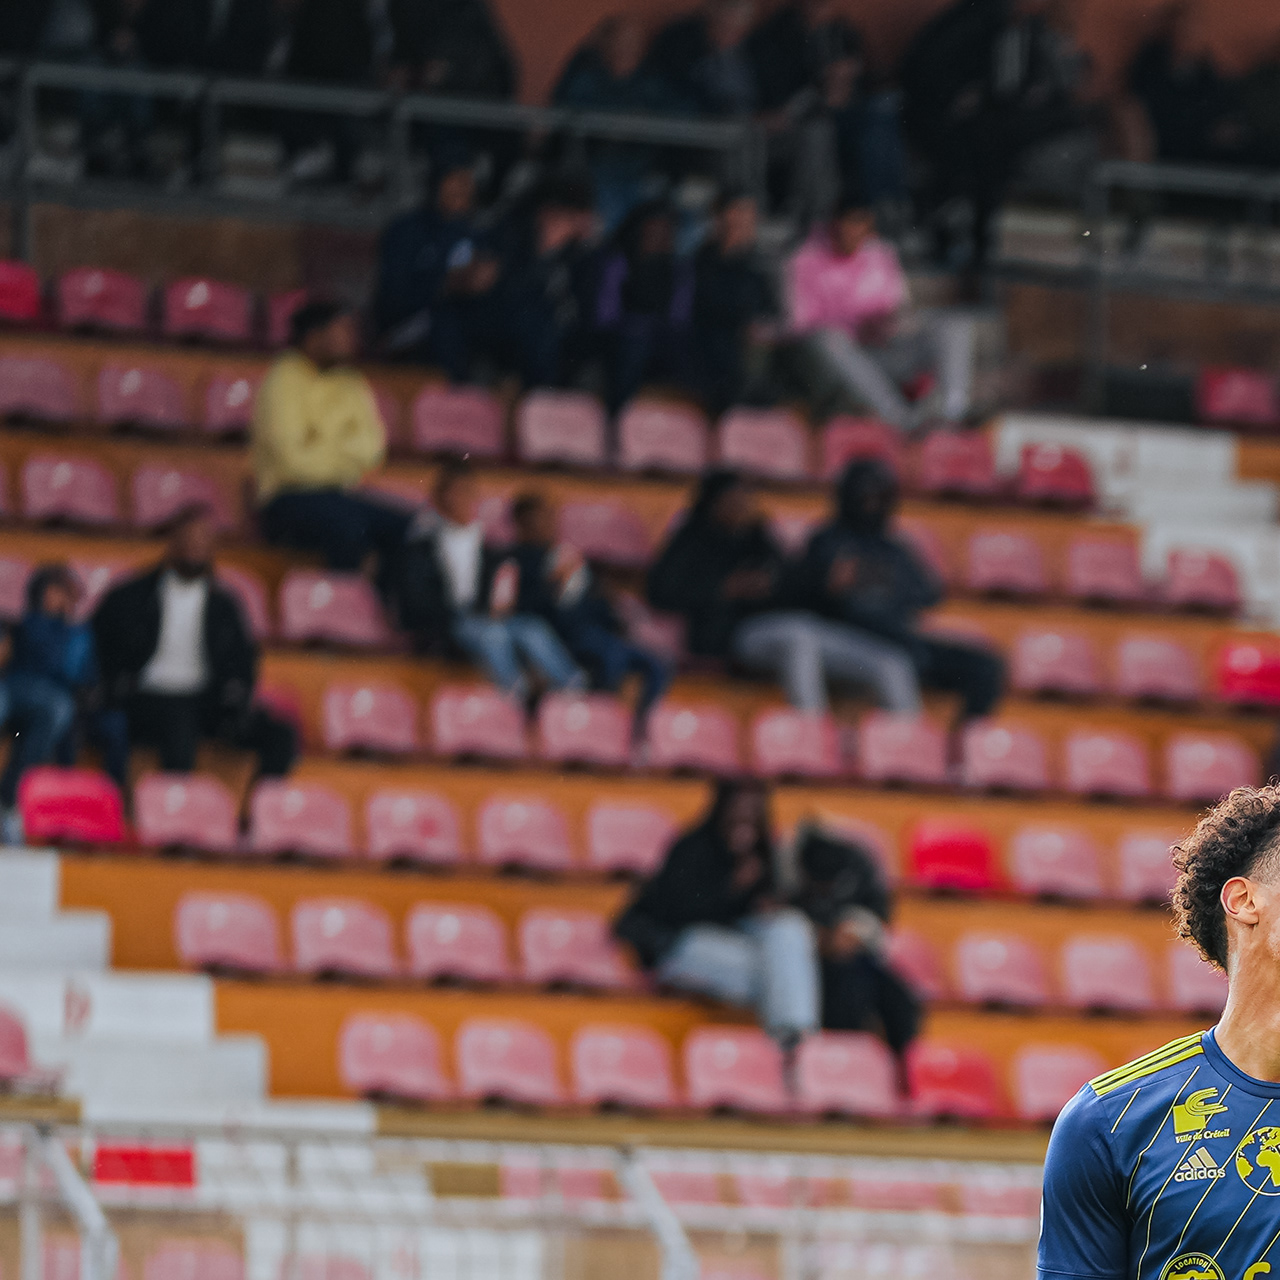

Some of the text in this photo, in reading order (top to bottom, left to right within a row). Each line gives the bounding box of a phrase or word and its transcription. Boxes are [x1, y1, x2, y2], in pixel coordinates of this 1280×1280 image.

[1175, 1134, 1192, 1144] Ville
[1203, 1128, 1231, 1140] Créteil
[1174, 1167, 1227, 1182] adidas
[1174, 1257, 1209, 1270] LOCATION
